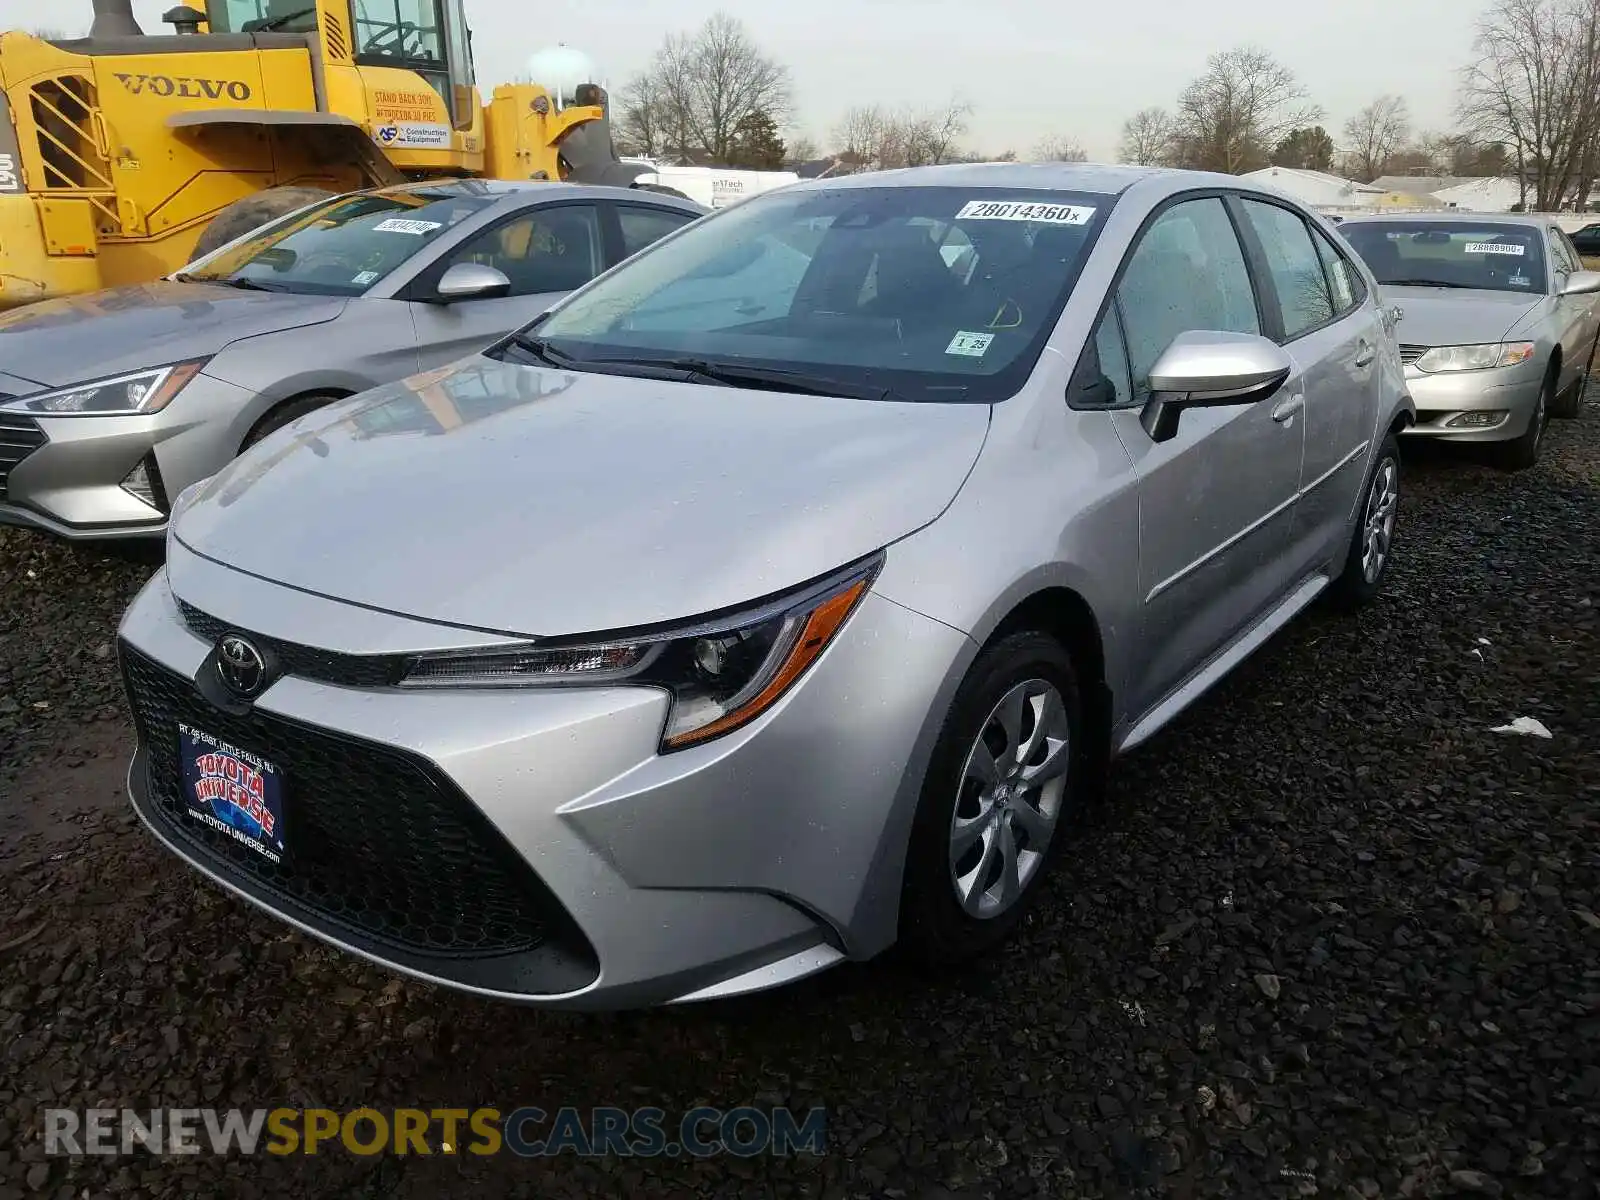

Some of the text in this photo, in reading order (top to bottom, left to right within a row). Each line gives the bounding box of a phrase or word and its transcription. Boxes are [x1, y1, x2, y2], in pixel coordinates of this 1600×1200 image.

[112, 72, 251, 101] VOLVO
[375, 91, 397, 103] STAND
[399, 93, 417, 105] BACK
[406, 128, 447, 137] Construction
[407, 136, 441, 144] Equipment
[969, 339, 987, 349] 25
[219, 741, 240, 758] LITTLE
[195, 753, 264, 804] TOYOTA
[194, 776, 275, 837] UNIVERSE
